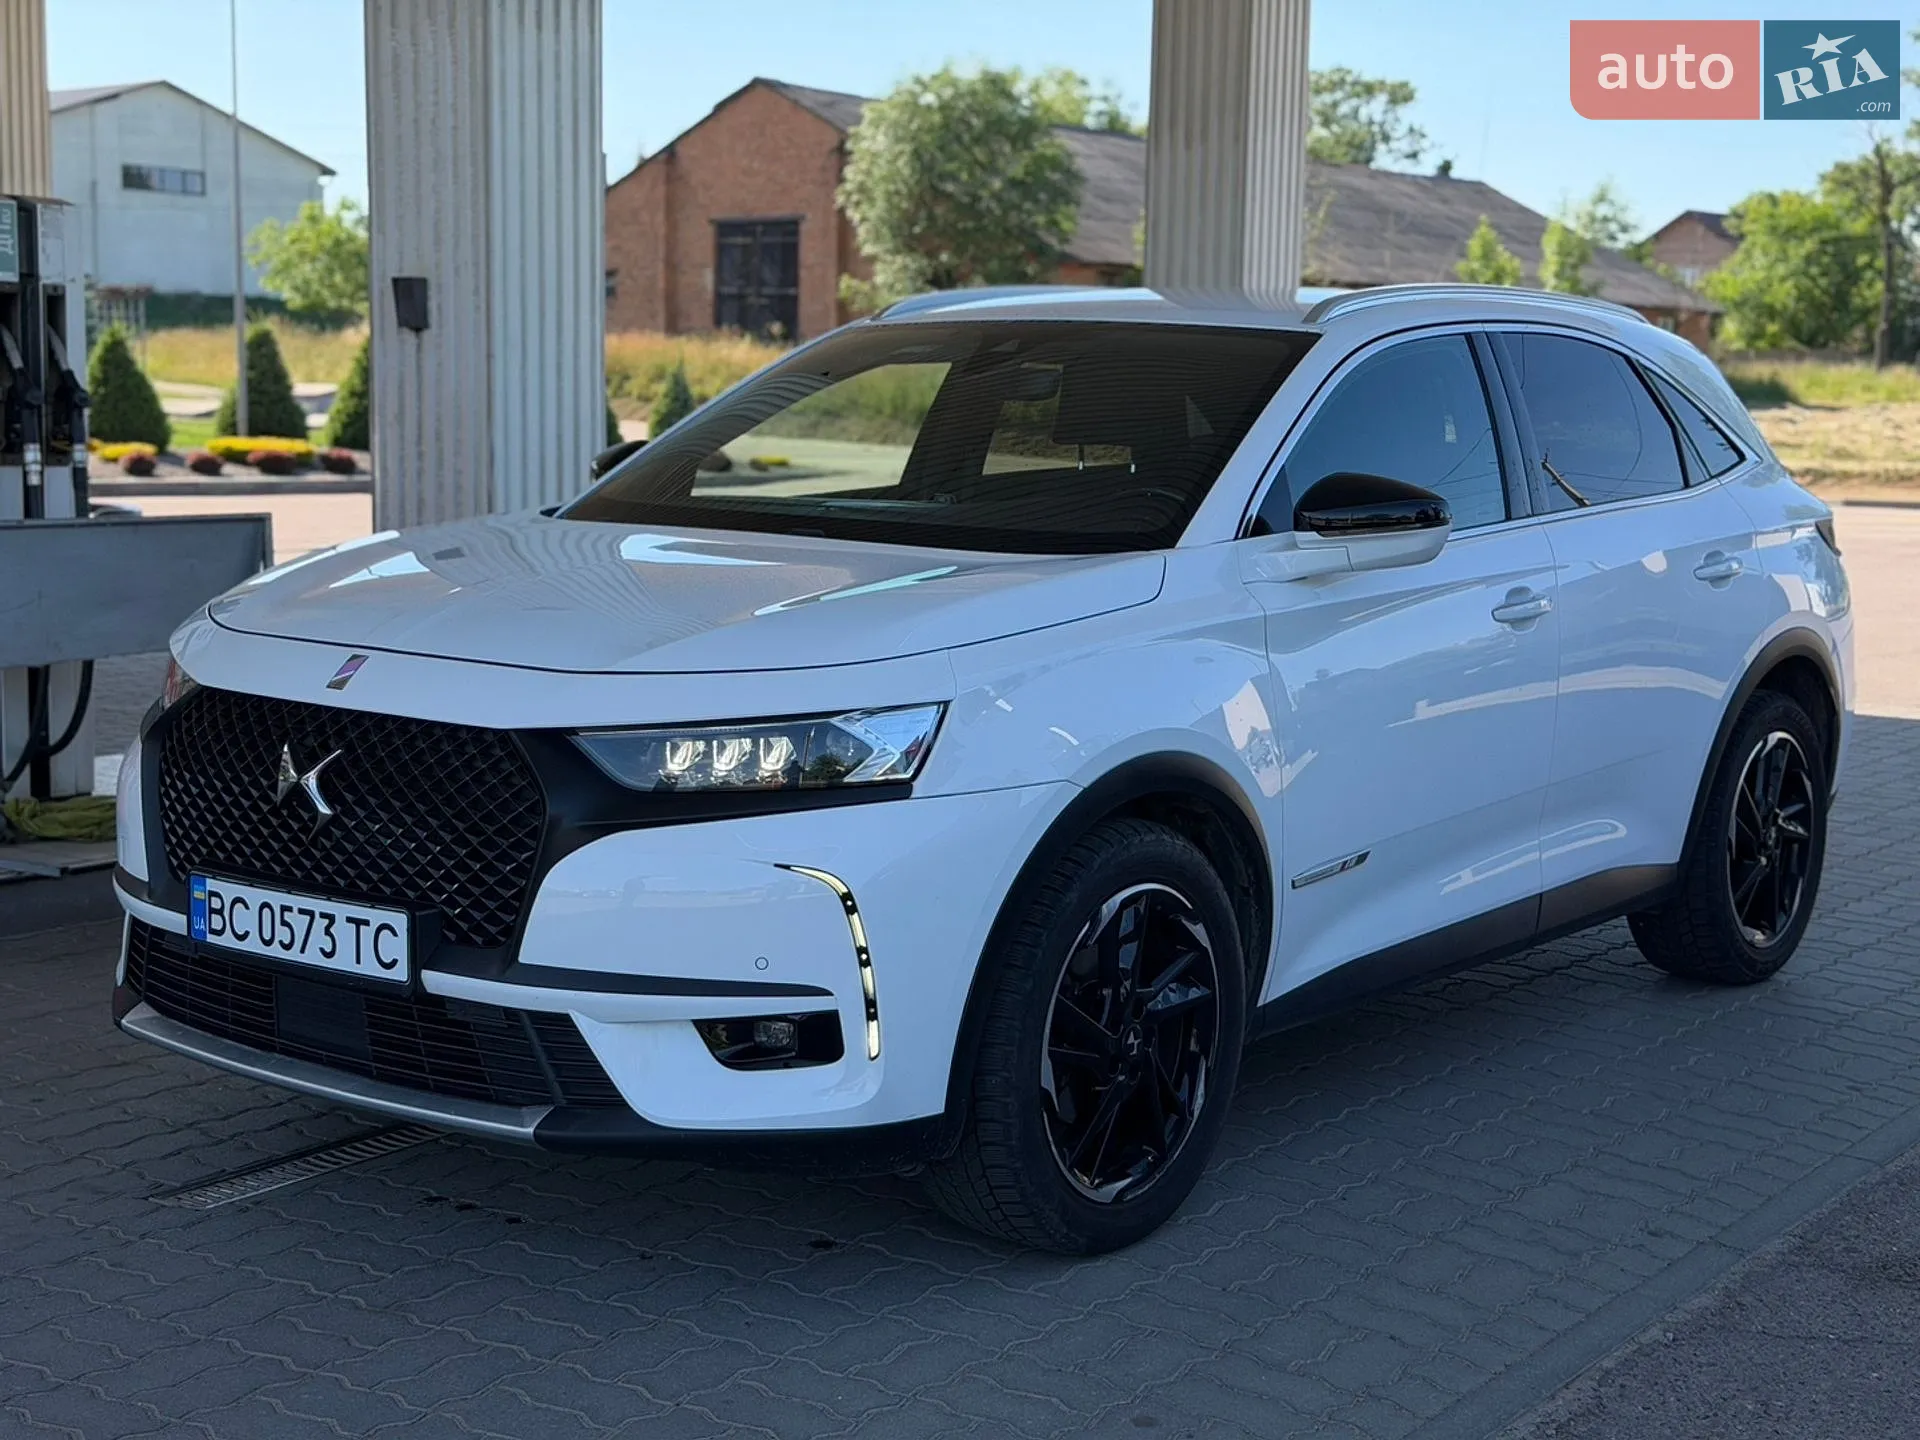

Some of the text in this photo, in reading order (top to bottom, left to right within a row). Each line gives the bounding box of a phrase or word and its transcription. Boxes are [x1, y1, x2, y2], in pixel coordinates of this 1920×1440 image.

[193, 915, 206, 931] UA
[207, 889, 399, 970] BC 0573 TC
